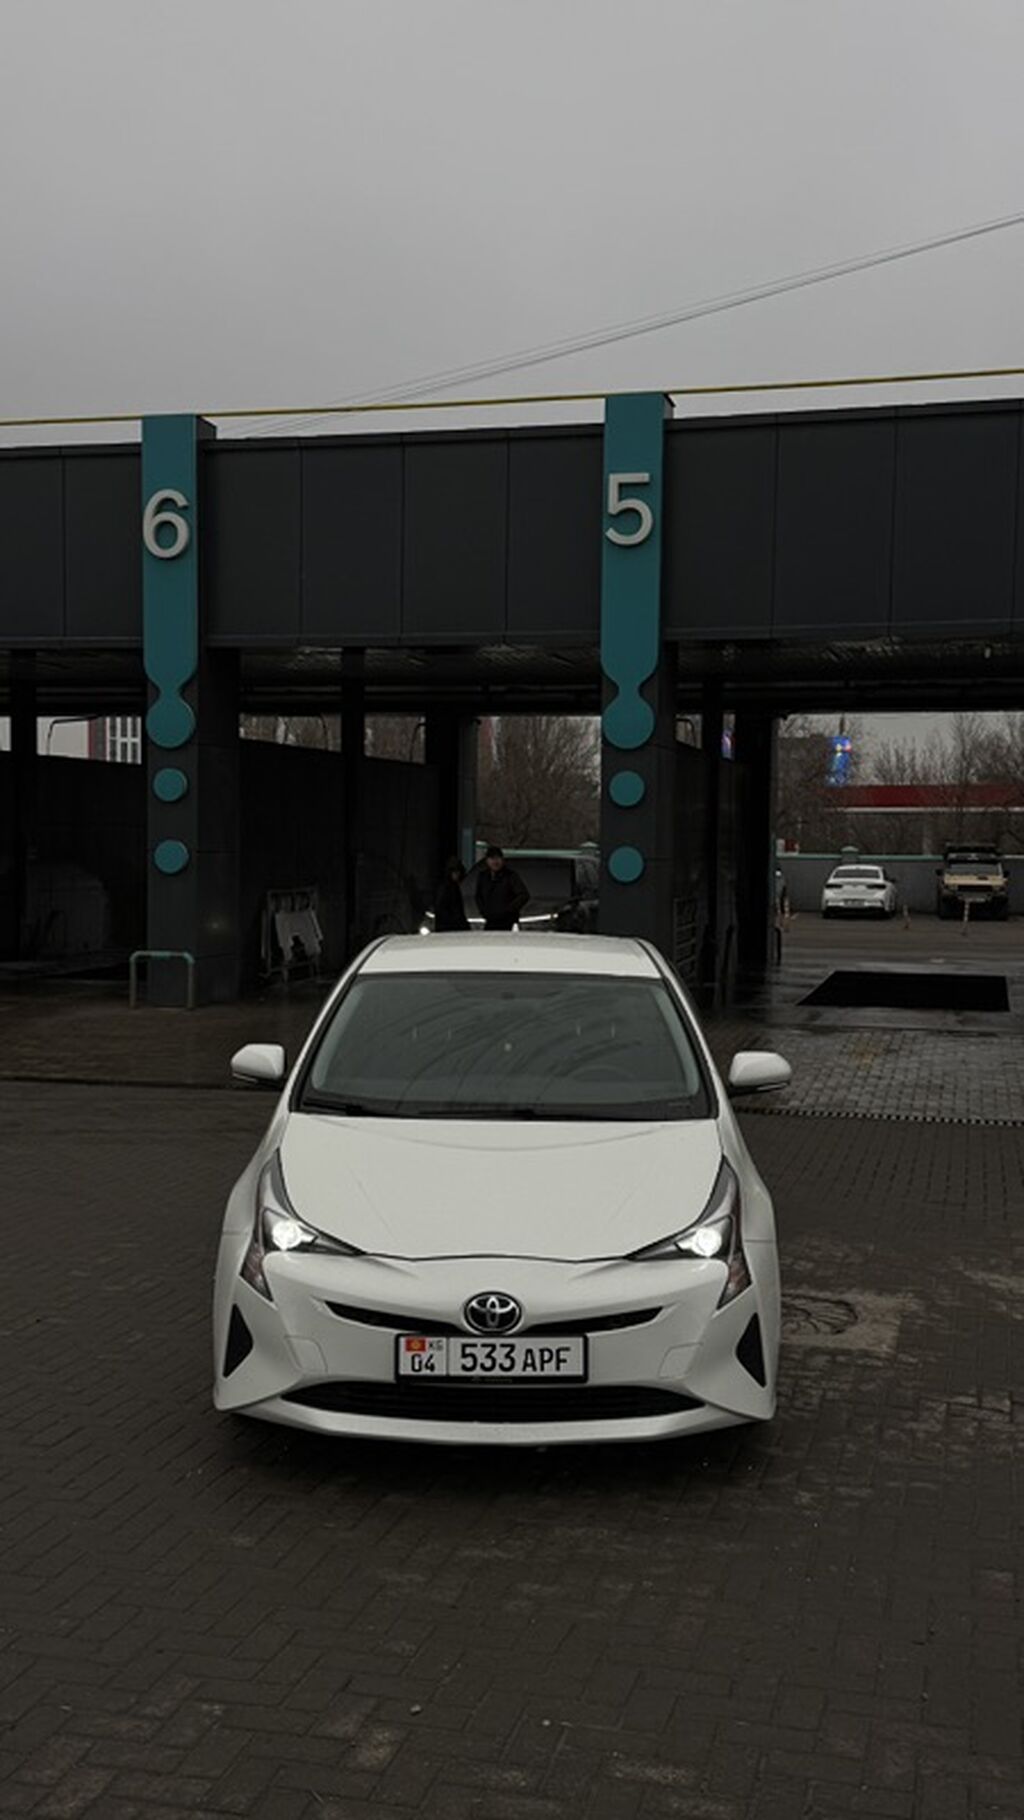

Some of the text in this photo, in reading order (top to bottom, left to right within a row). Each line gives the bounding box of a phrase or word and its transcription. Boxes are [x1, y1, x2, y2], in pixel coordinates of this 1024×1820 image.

[143, 489, 189, 558] 6
[605, 473, 653, 545] 5
[411, 1353, 435, 1372] 04
[461, 1343, 571, 1372] 533 APF
